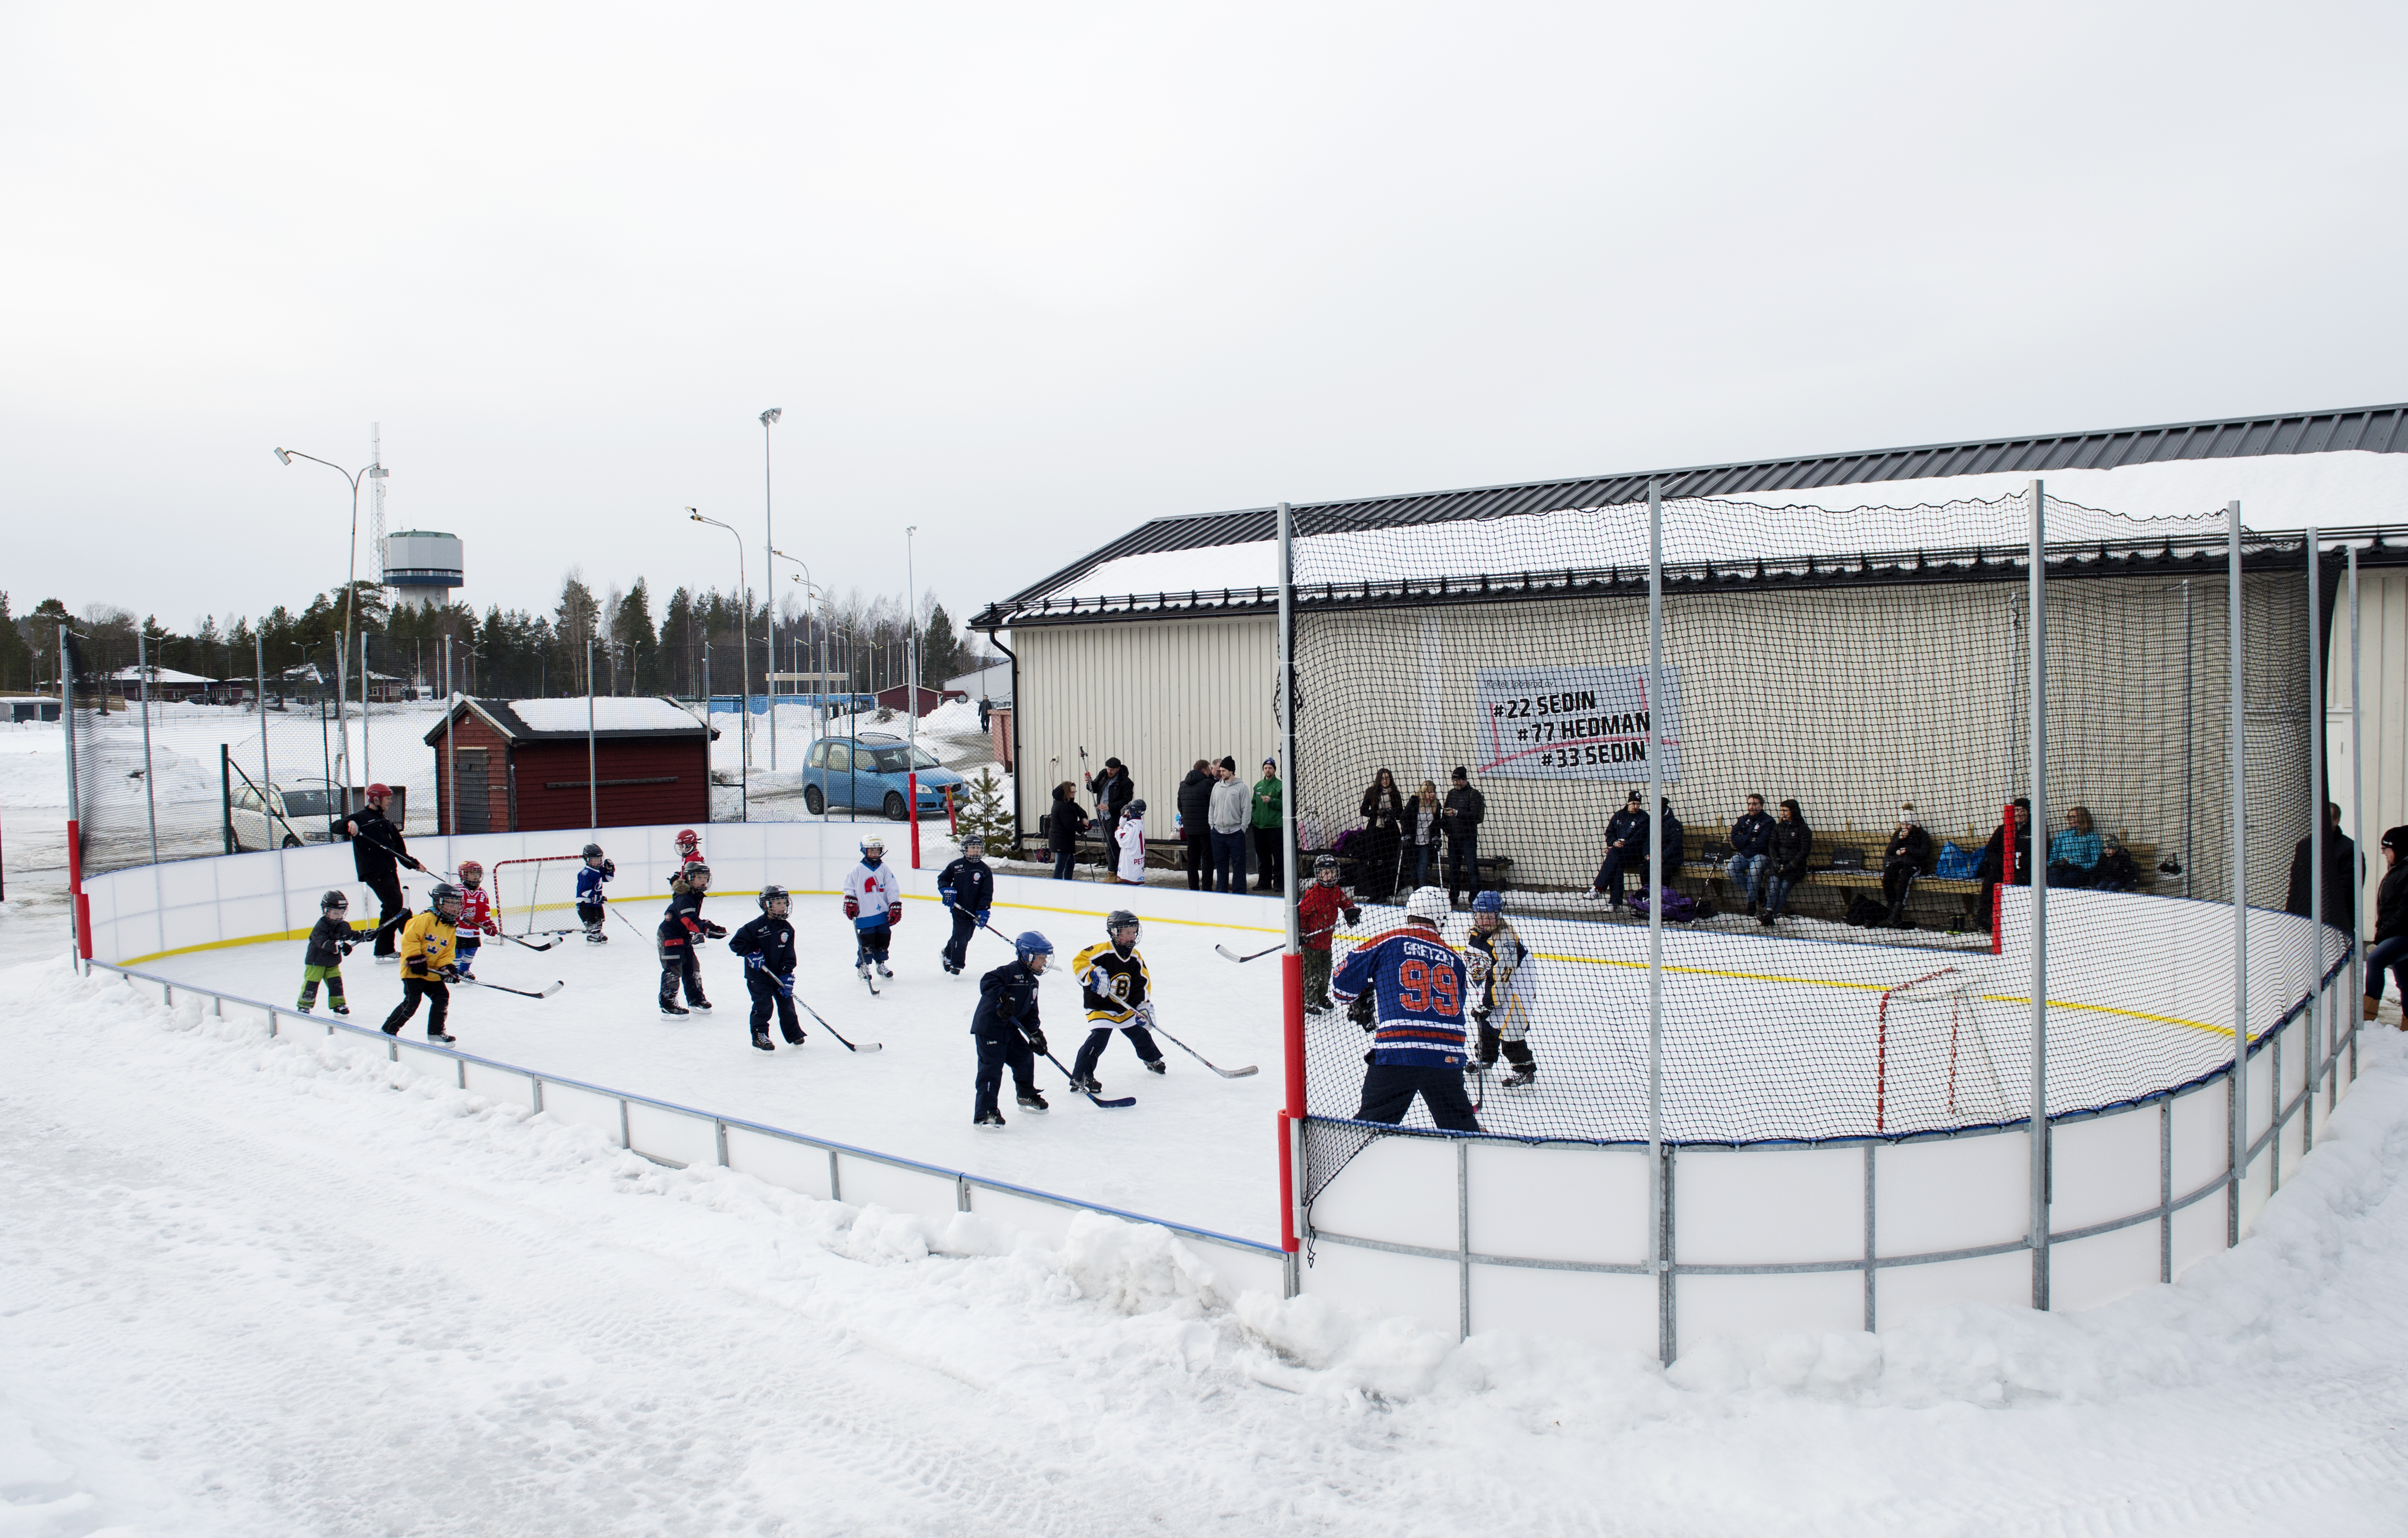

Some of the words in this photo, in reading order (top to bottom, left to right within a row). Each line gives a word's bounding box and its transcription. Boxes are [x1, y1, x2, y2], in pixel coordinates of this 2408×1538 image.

[1493, 699, 1530, 719] #22
[1537, 690, 1595, 716] SEDIN
[1518, 723, 1554, 743] #77
[1561, 711, 1650, 740] HEDMAN
[1541, 747, 1580, 768] #33
[1585, 741, 1646, 765] SEDIN
[1115, 980, 1128, 997] B
[1399, 958, 1461, 1017] 99
